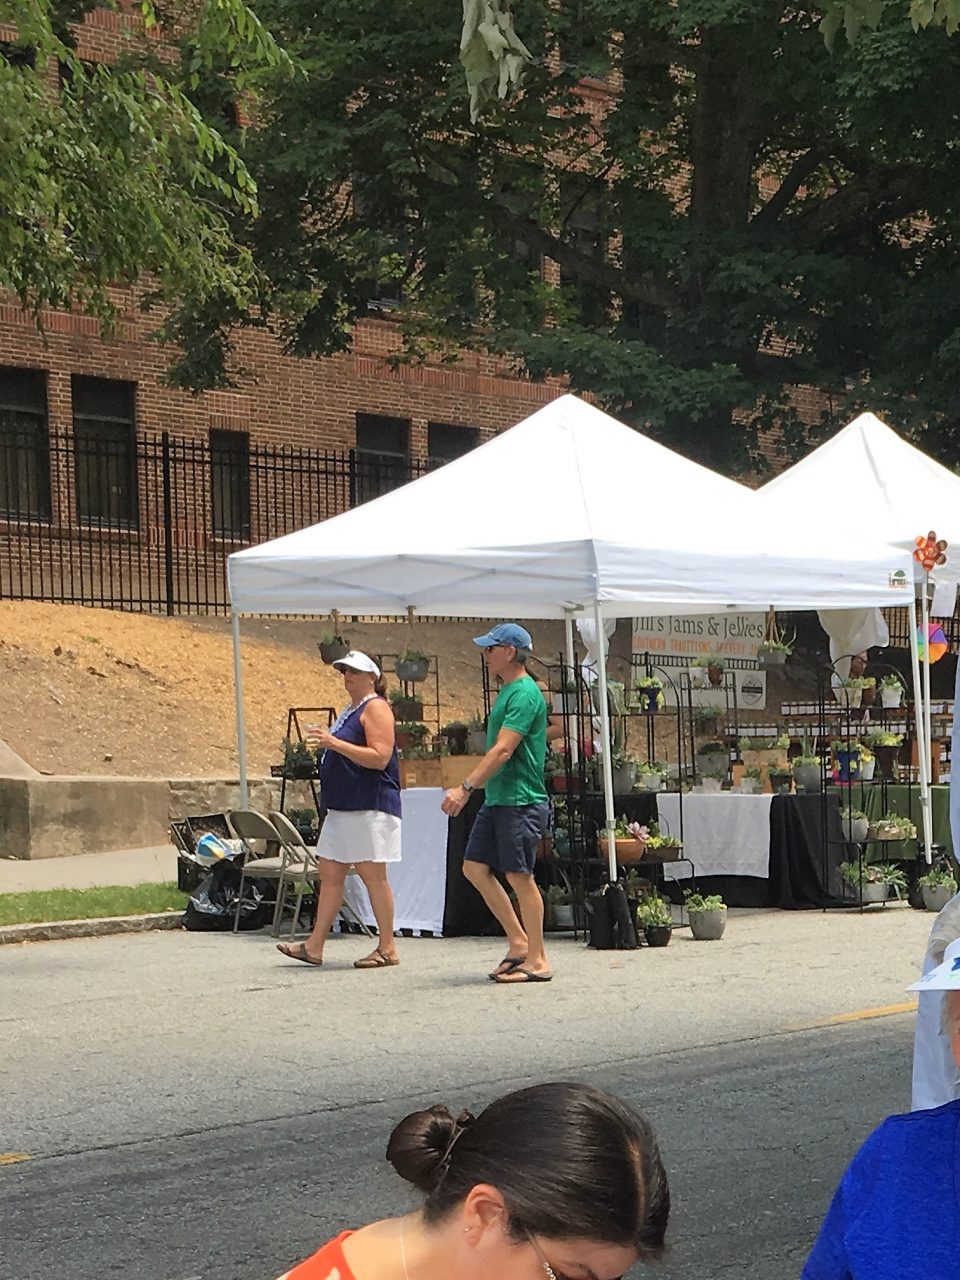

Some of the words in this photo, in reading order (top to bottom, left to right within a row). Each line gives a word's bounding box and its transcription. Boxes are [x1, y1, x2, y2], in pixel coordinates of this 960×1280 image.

[668, 615, 704, 635] Jams
[707, 617, 720, 636] &
[723, 616, 763, 639] Jellies
